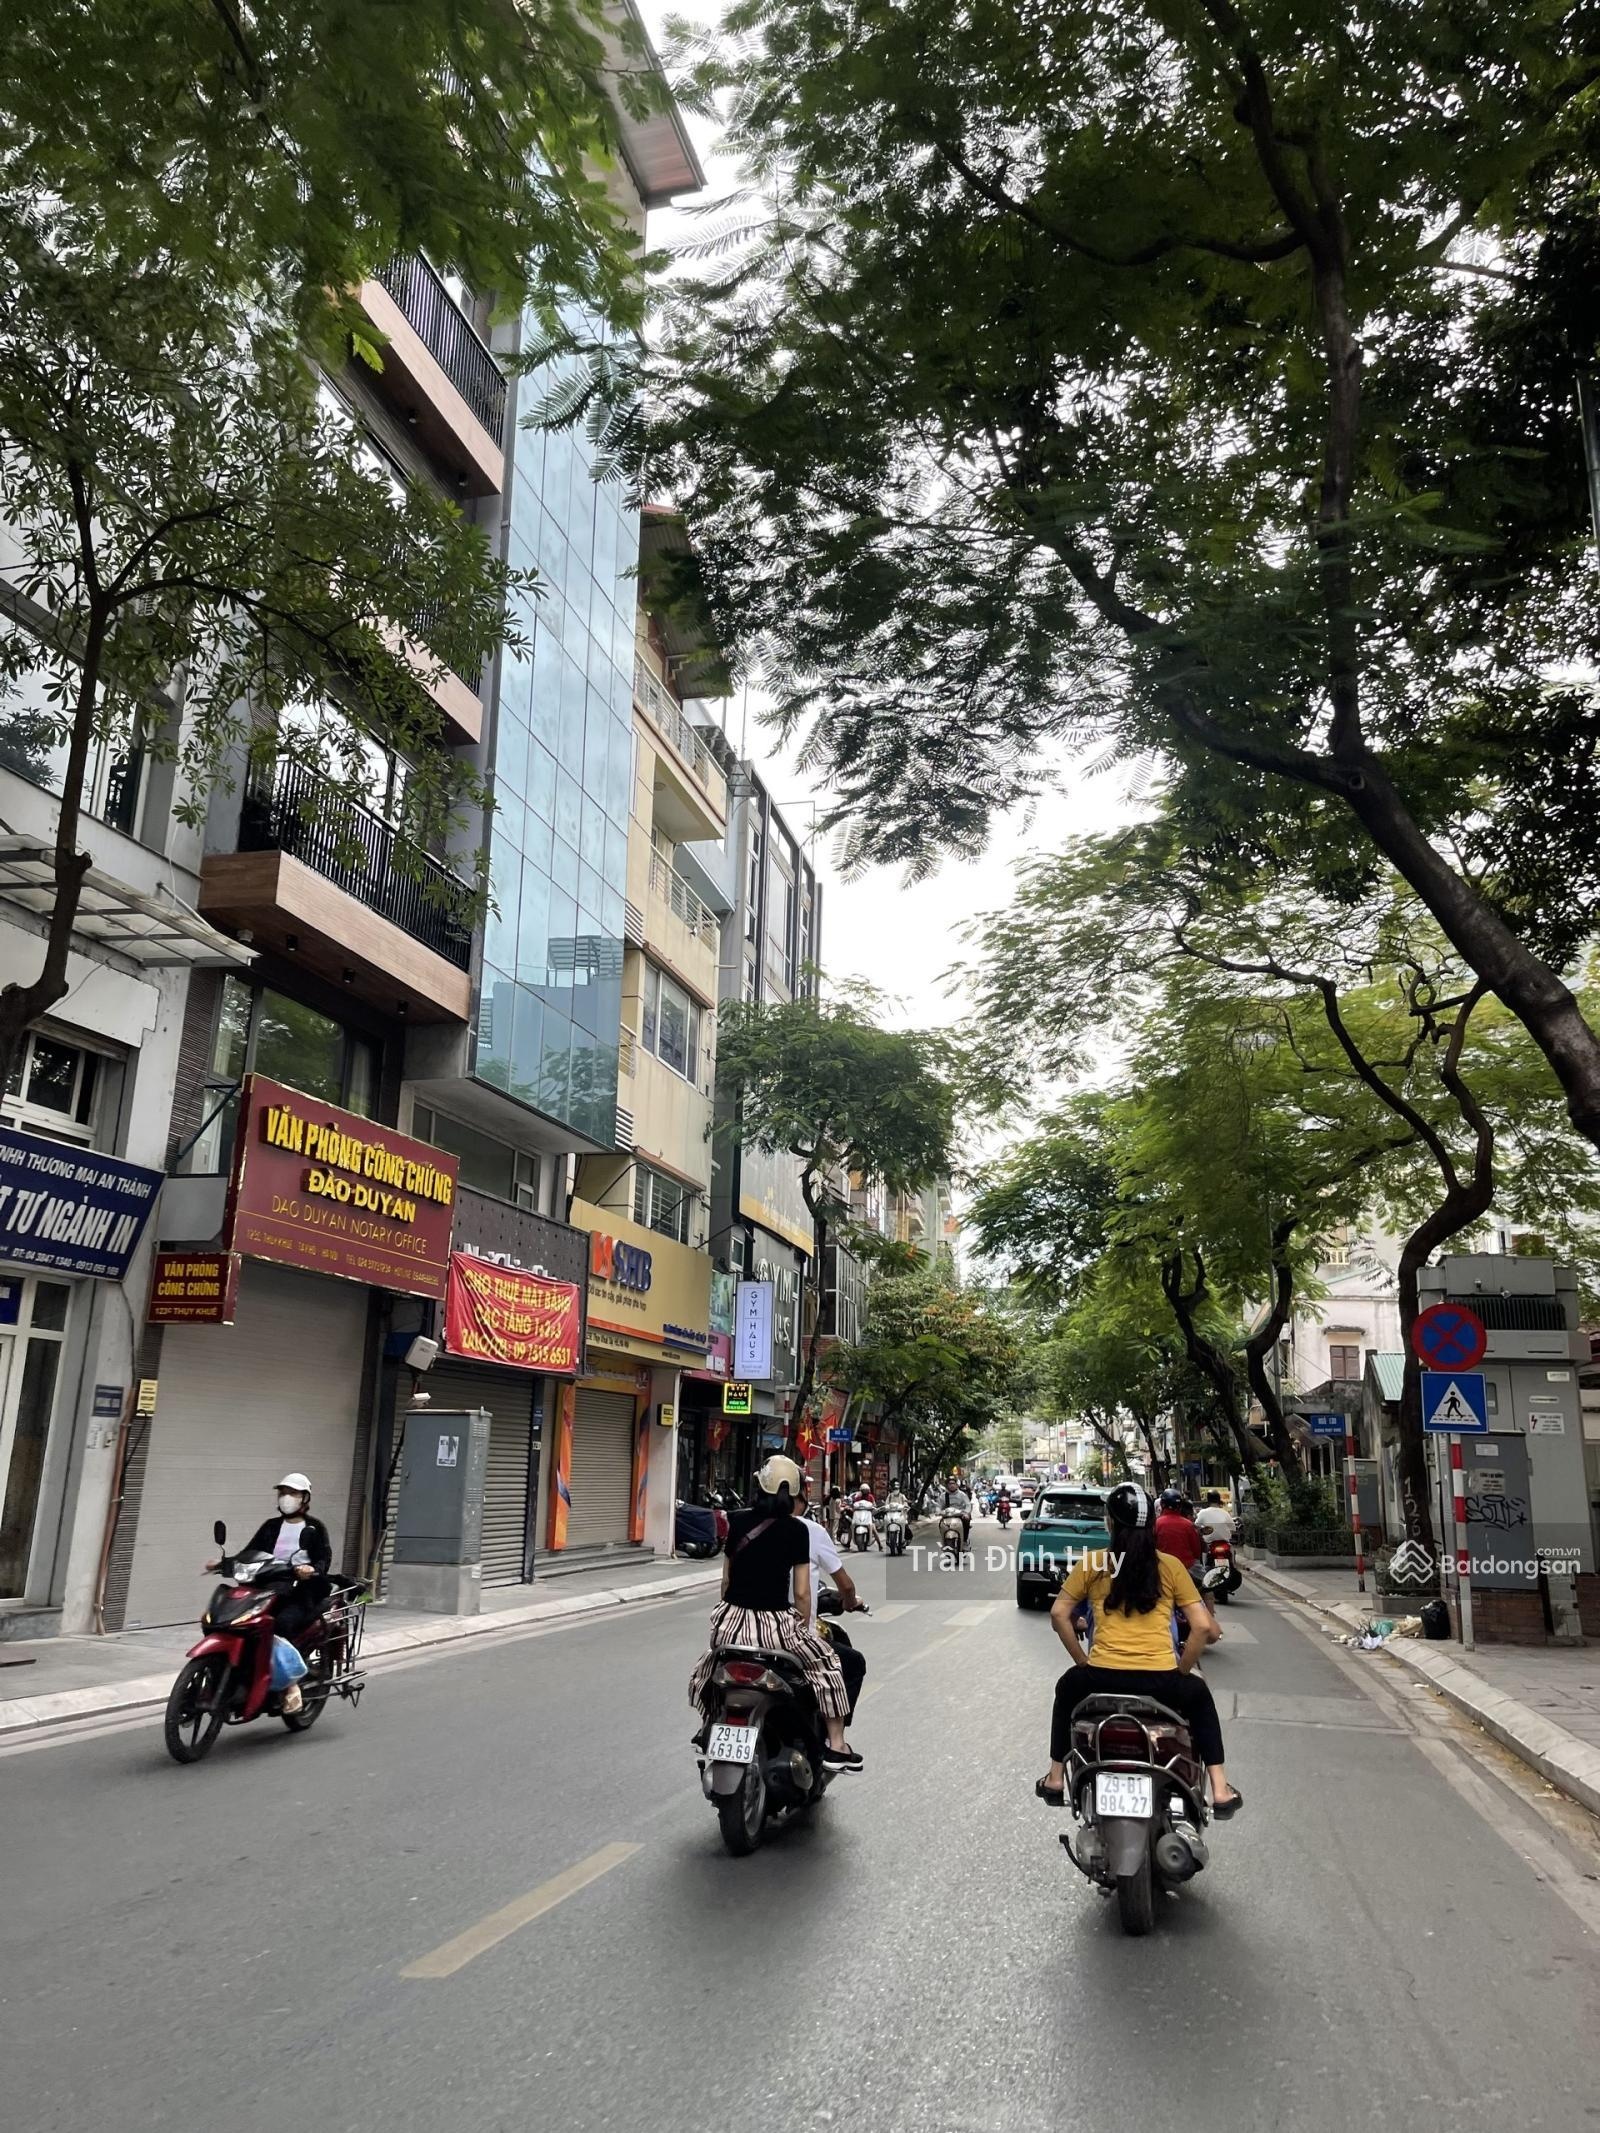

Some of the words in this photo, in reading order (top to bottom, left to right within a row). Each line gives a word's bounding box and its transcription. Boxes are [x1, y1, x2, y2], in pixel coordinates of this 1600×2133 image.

[266, 1105, 303, 1153] VĂN
[304, 1121, 363, 1175] PHÒNG
[364, 1142, 405, 1189] CÔNG
[406, 1161, 453, 1205] CHỨNG
[27, 1152, 75, 1179] THƯƠNG
[74, 1166, 98, 1188] MẠI
[97, 1173, 117, 1189] AN
[116, 1177, 152, 1199] THÀNH
[308, 1168, 351, 1202] ĐÀO
[5, 1189, 49, 1234] TƯ
[34, 1195, 116, 1250] NGÀNH
[106, 1214, 139, 1255] IN
[351, 1217, 394, 1244] NOTARY
[394, 1231, 428, 1255] OFFICE
[164, 1261, 185, 1277] VĂN
[186, 1260, 220, 1277] PHÒNG
[614, 1239, 653, 1292] SHB
[158, 1280, 185, 1296] CÔNG
[187, 1280, 220, 1296] CHỨNG
[495, 1278, 520, 1302] THUÊ
[749, 1290, 758, 1317] GYM
[710, 1742, 751, 1760] 463.69
[1104, 1776, 1143, 1794] 29-B1
[1100, 1796, 1148, 1814] 984.27
